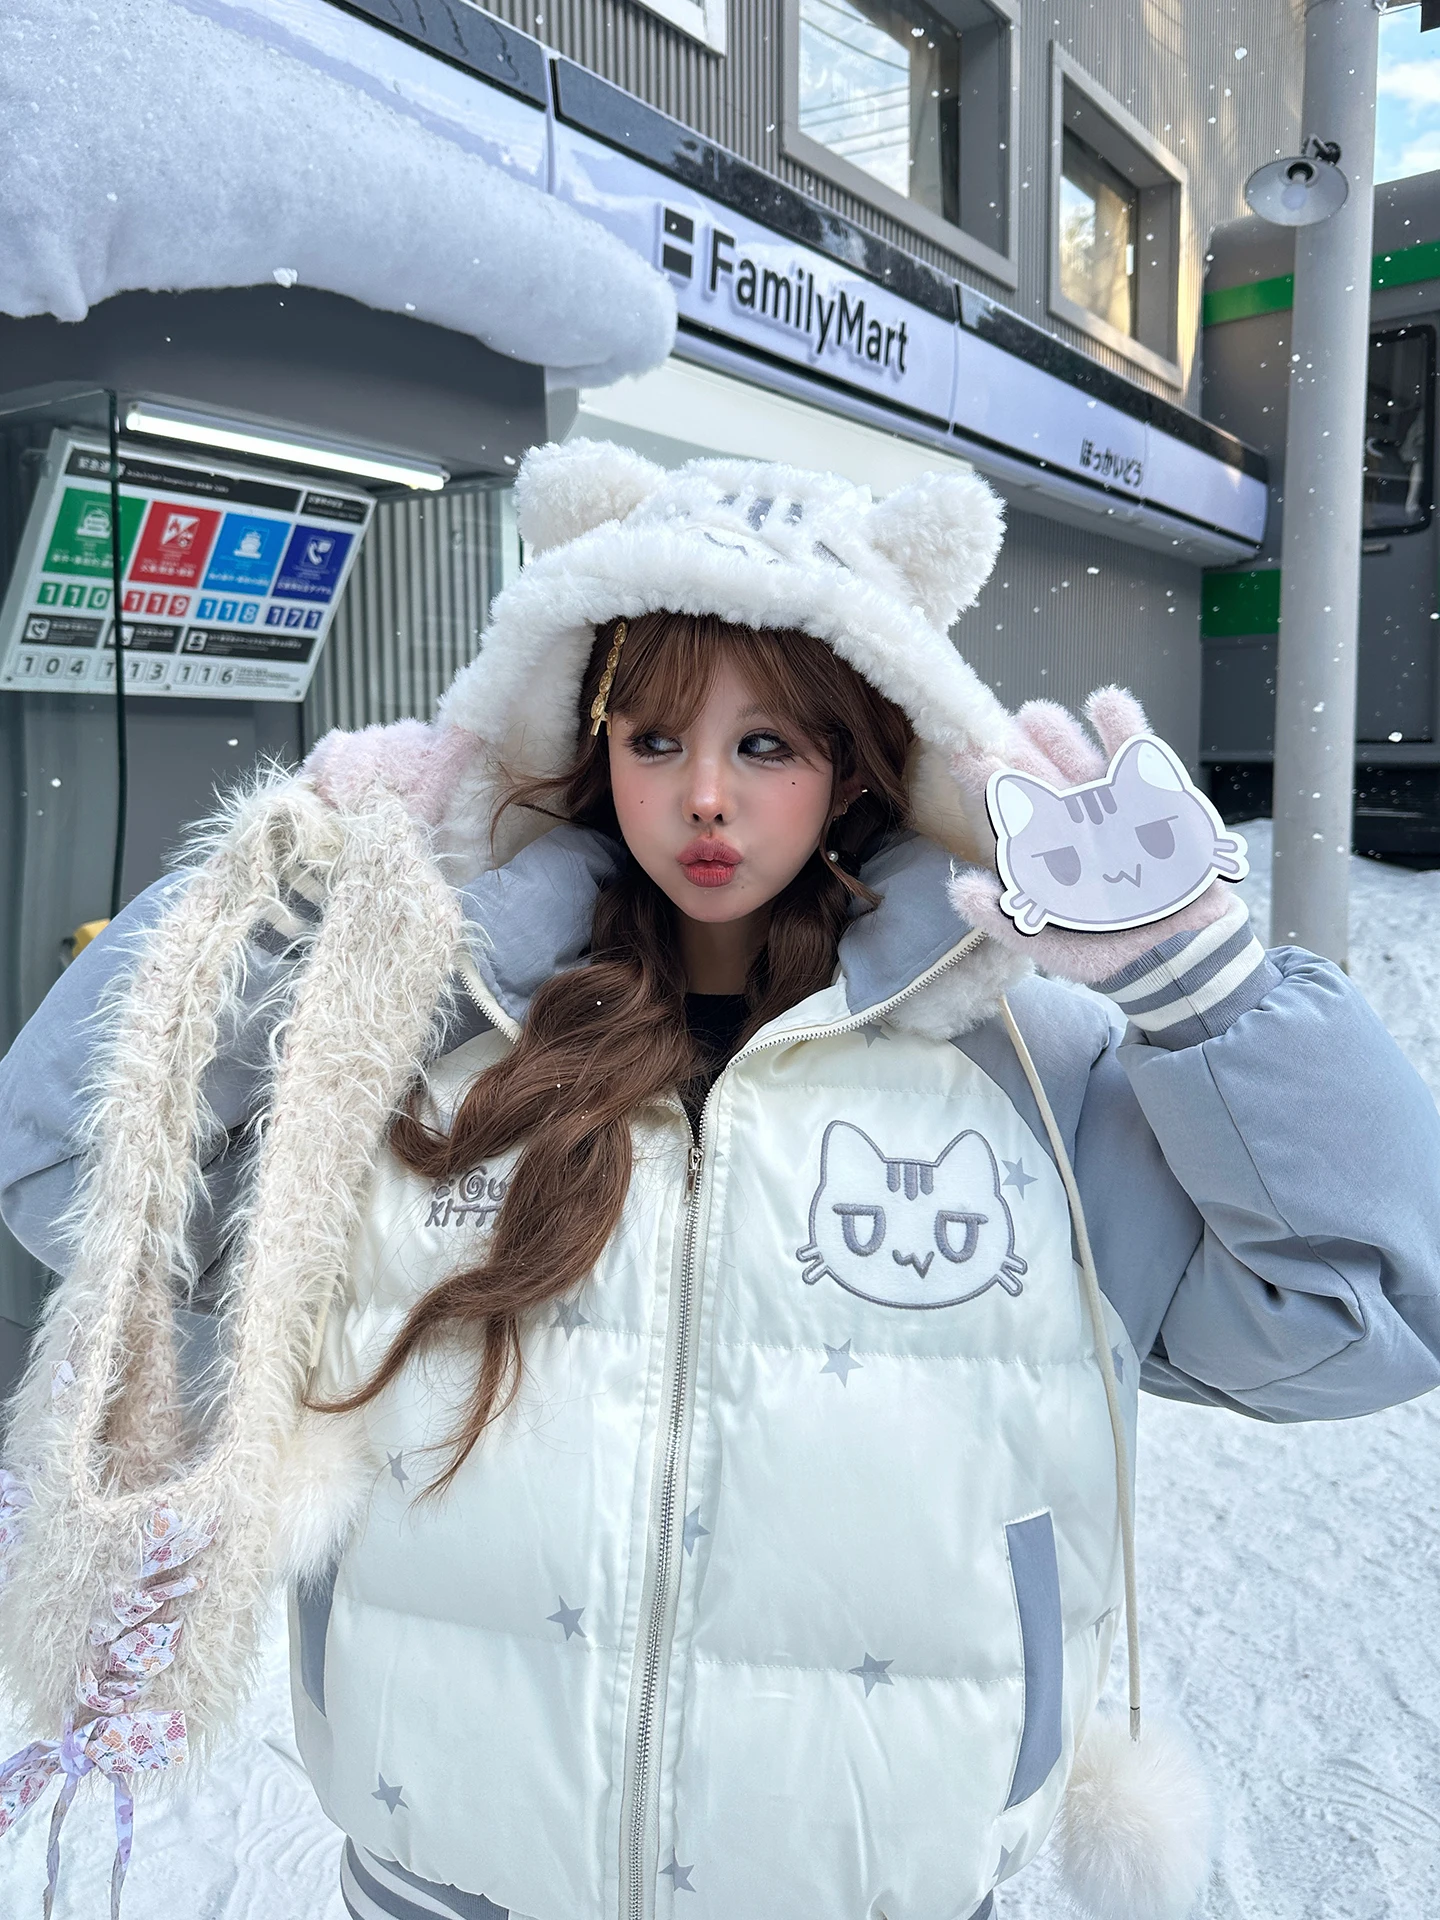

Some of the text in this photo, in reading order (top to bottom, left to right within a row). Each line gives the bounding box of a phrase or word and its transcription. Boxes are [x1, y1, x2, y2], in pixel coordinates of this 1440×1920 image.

[709, 227, 908, 374] FamilyMart
[1080, 438, 1144, 488] ほっかいどう
[44, 582, 108, 608] 110
[130, 591, 189, 615] 119
[202, 600, 256, 623] 118
[271, 607, 321, 629] 171
[24, 656, 84, 676] 104
[105, 660, 164, 681] 113
[182, 666, 233, 684] 116
[424, 1197, 502, 1228] KITT
